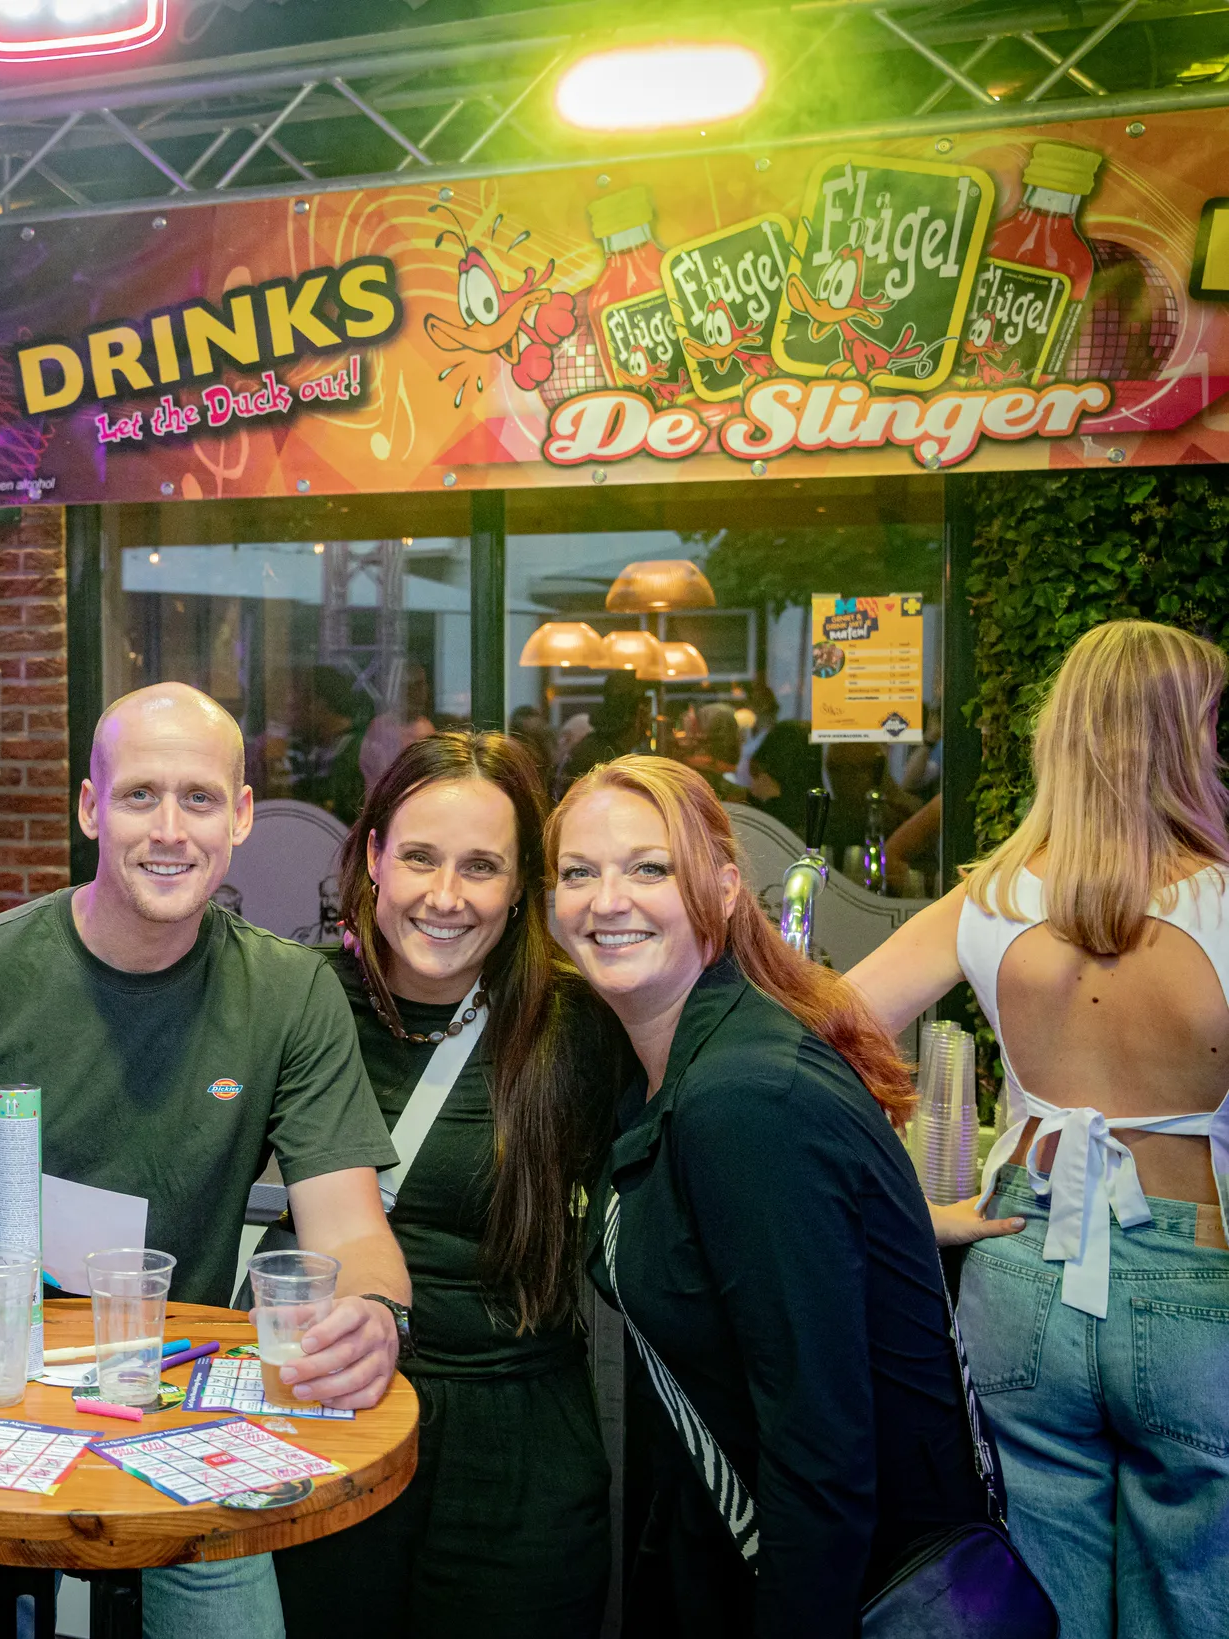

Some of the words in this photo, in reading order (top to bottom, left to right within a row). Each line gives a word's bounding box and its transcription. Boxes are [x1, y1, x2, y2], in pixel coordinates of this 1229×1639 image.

[672, 220, 787, 328] Flügel
[812, 160, 972, 301] Flügel
[17, 264, 396, 416] DRINKS
[607, 308, 679, 362] Flüge
[969, 263, 1060, 346] Flügel
[96, 413, 142, 444] Let
[150, 395, 199, 435] the
[202, 370, 291, 427] Duck
[300, 355, 361, 402] out!
[545, 393, 705, 463] De
[724, 382, 1108, 463] Slinger
